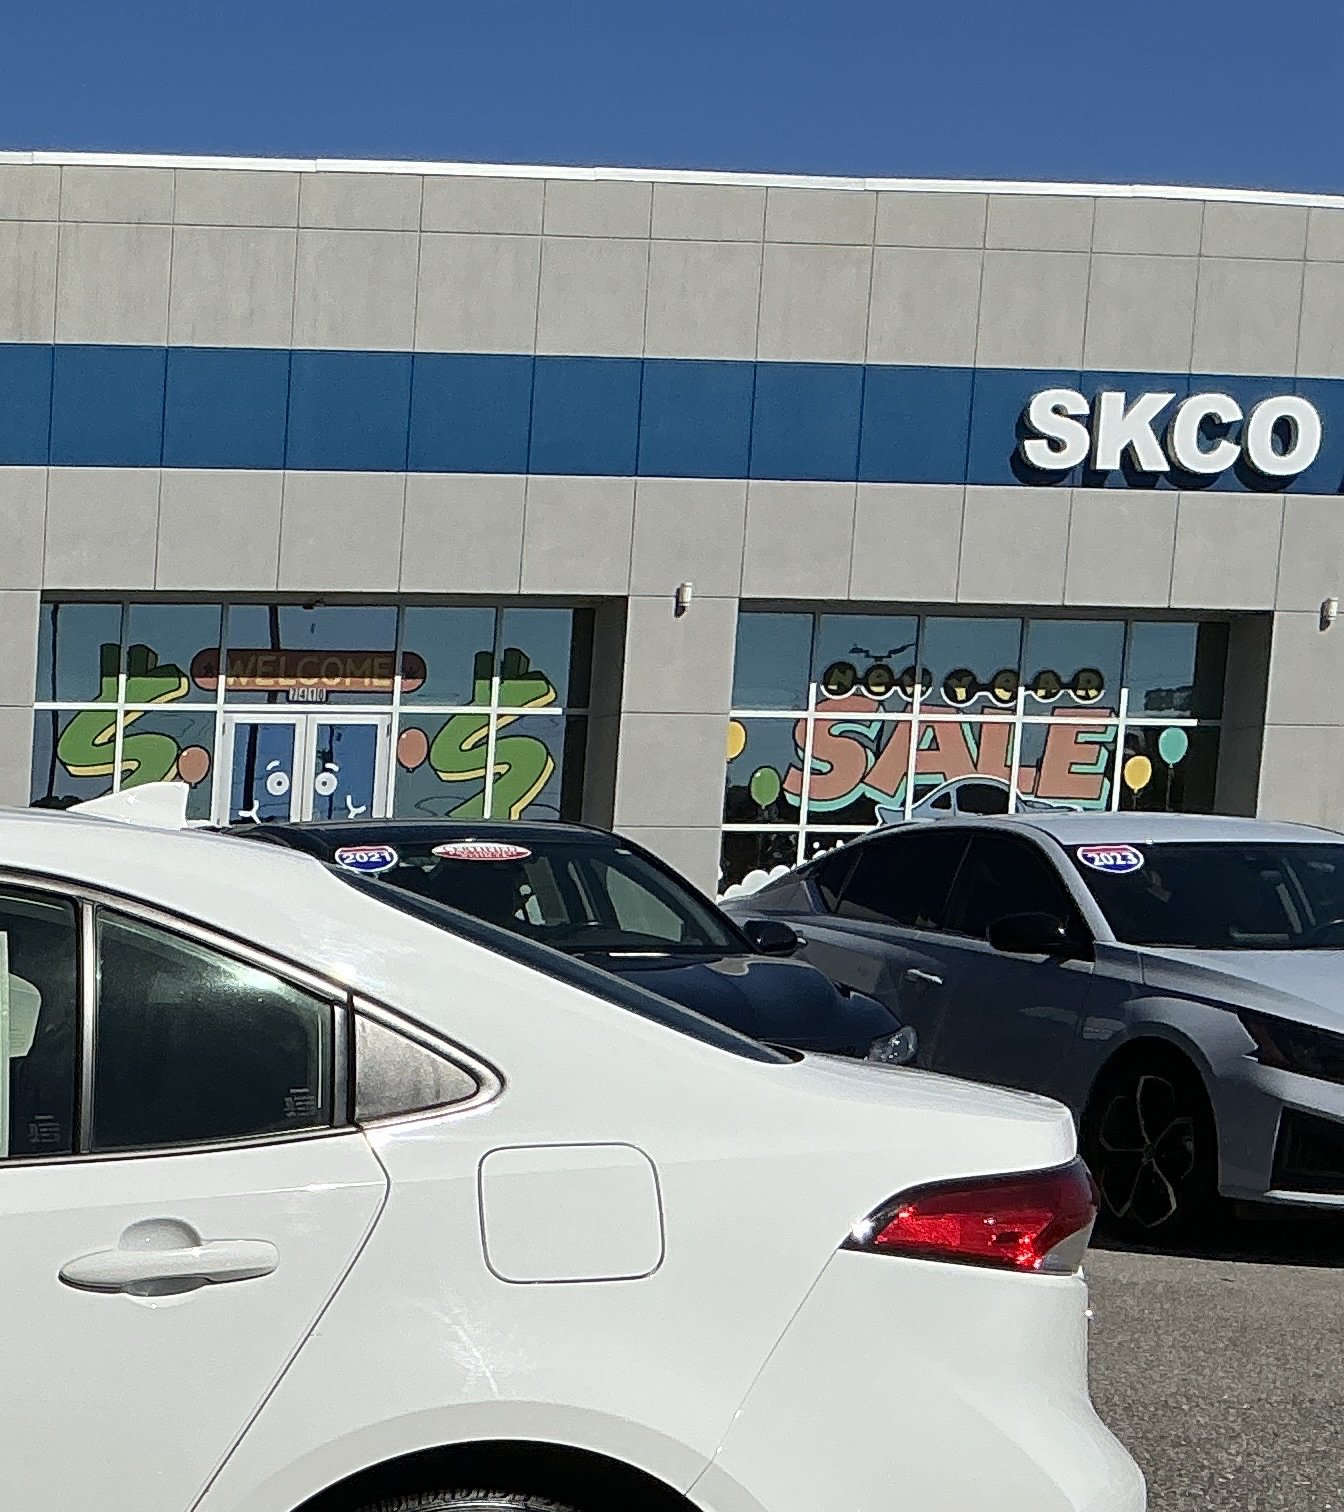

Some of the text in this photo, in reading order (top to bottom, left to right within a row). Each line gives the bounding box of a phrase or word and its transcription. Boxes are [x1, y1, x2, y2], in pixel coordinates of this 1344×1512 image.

[1023, 388, 1322, 476] SKCO
[226, 655, 392, 687] WELCOME
[783, 695, 1118, 812] SALE
[343, 852, 391, 863] 2021
[1093, 852, 1138, 866] 2023
